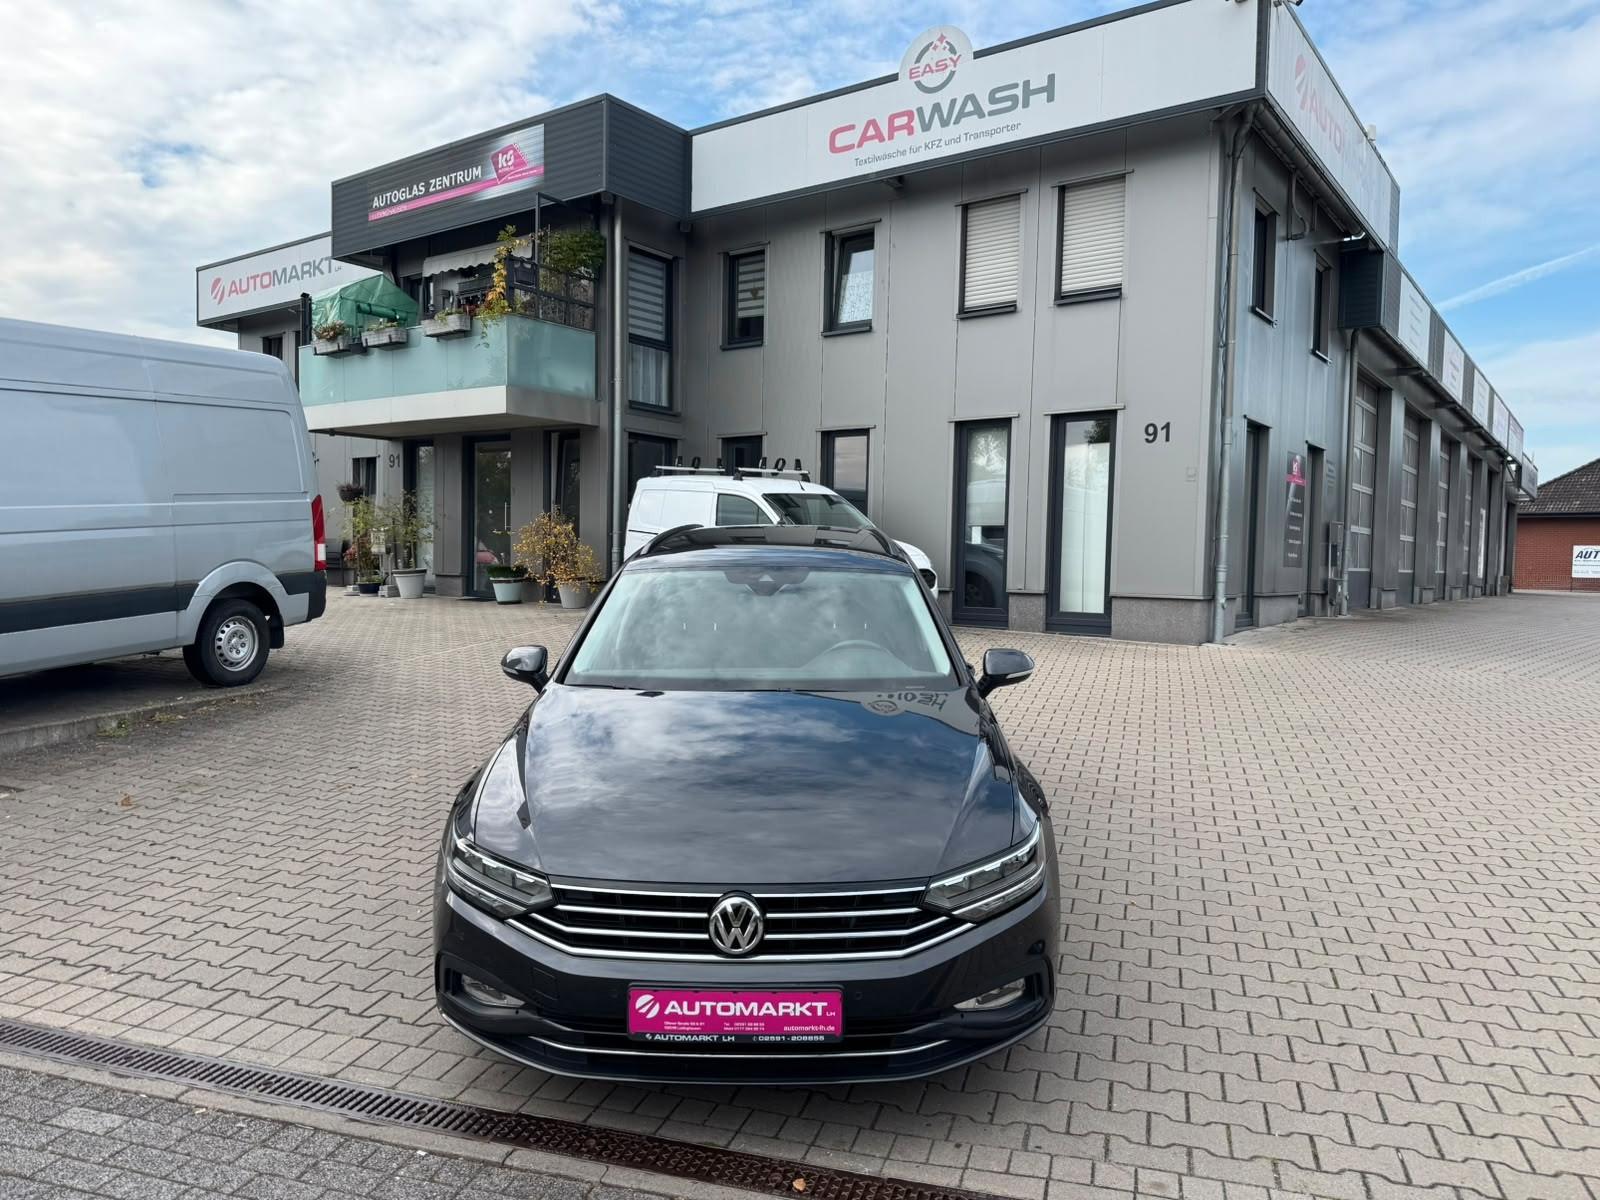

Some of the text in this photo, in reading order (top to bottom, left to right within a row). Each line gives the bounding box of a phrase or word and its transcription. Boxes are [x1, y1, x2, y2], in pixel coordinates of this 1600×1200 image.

[909, 54, 962, 80] EASY
[829, 72, 1056, 154] CARWASH
[924, 138, 943, 151] KFZ
[944, 134, 961, 146] und
[963, 122, 1021, 142] Transporter
[372, 166, 482, 209] AUTOGLAS ZENTRUM
[228, 257, 333, 297] AUTOMARKT
[1144, 421, 1171, 444] 91
[389, 453, 401, 468] 91
[711, 899, 761, 952] VW
[664, 1001, 828, 1017] AUTOMARKT
[654, 1034, 719, 1042] AUTOMARKT
[783, 1025, 836, 1033] automarkt-lh.de
